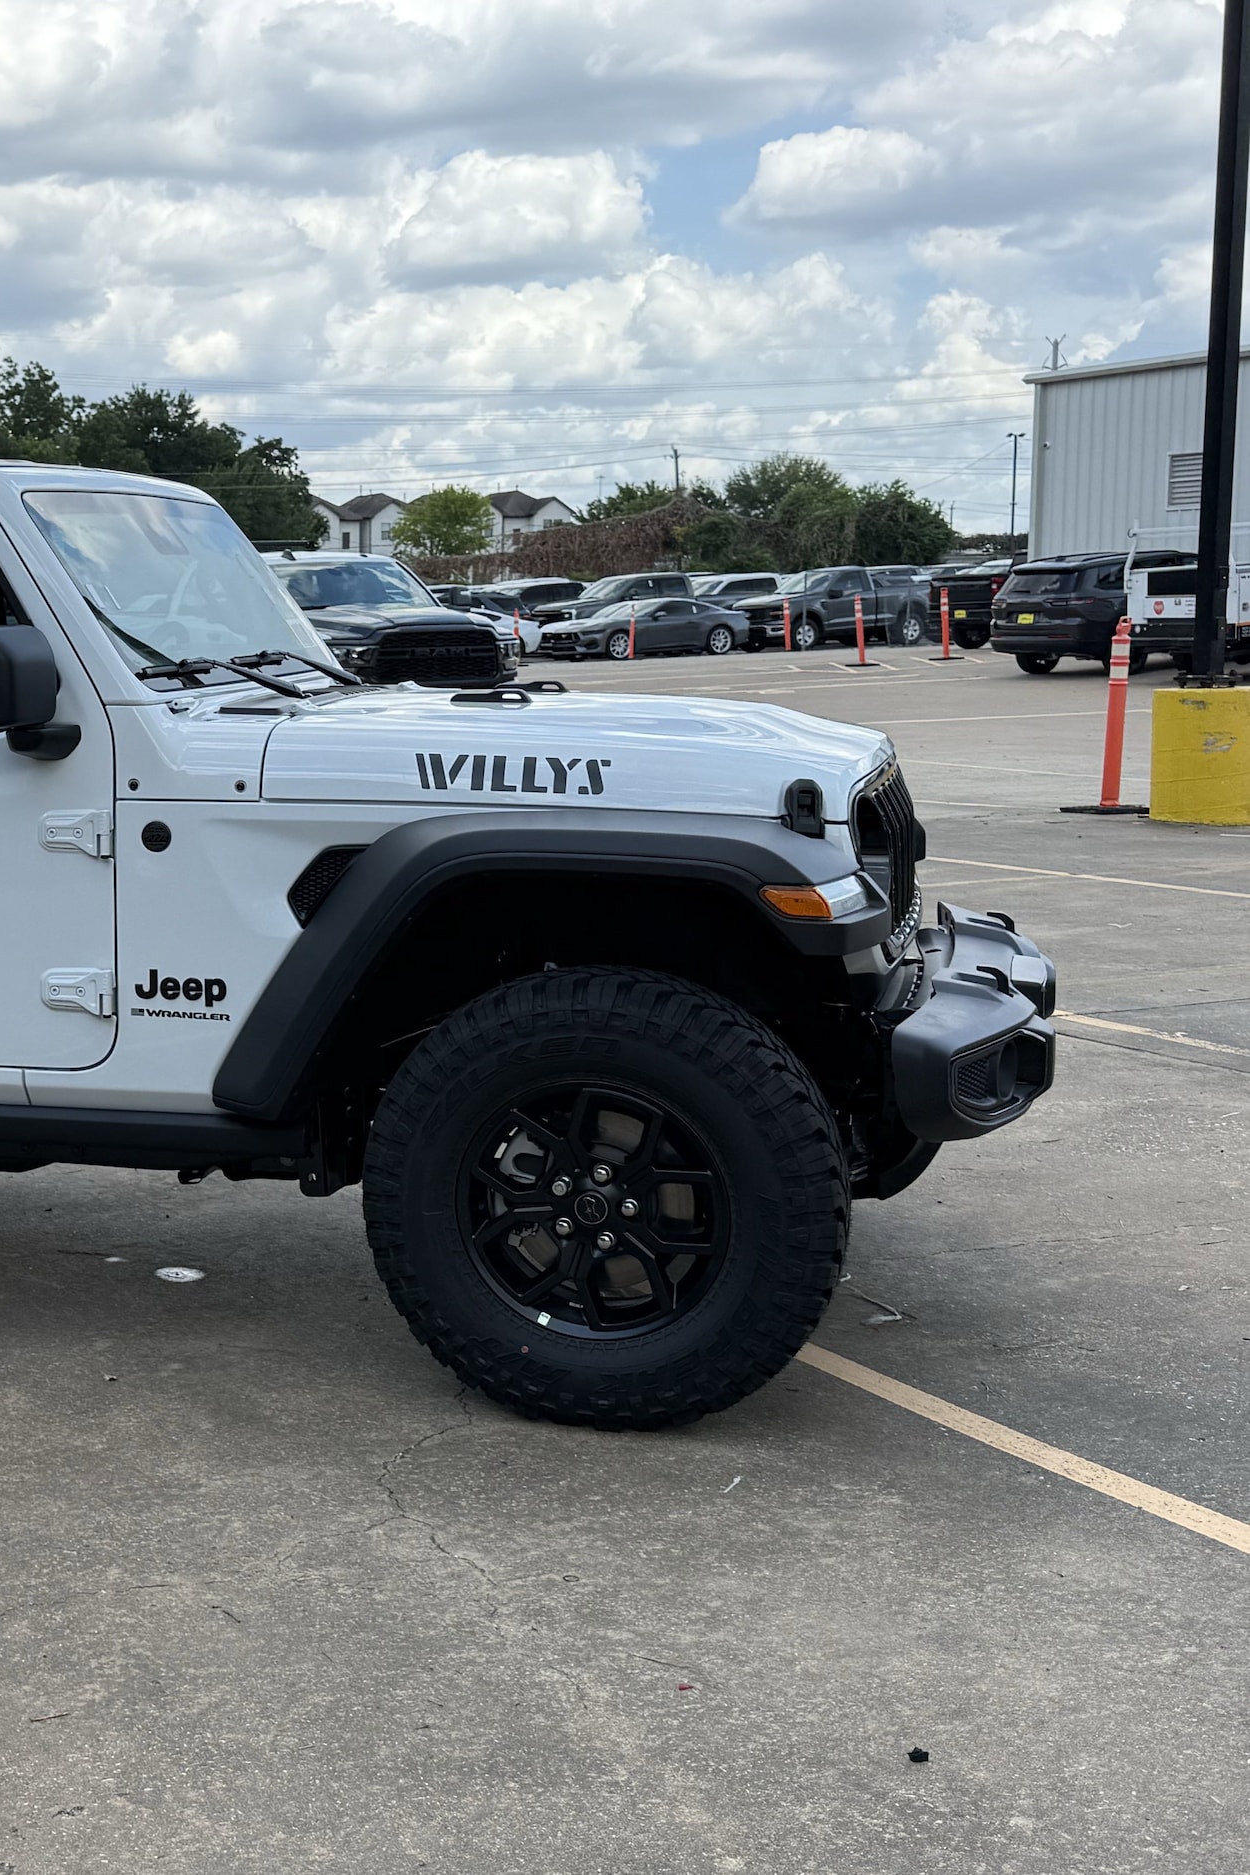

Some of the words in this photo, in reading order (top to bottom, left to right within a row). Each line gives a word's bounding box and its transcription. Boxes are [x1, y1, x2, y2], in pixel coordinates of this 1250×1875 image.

[415, 753, 611, 795] WILLYS
[135, 969, 227, 1007] Jeep
[146, 1009, 231, 1021] WRANGLER
